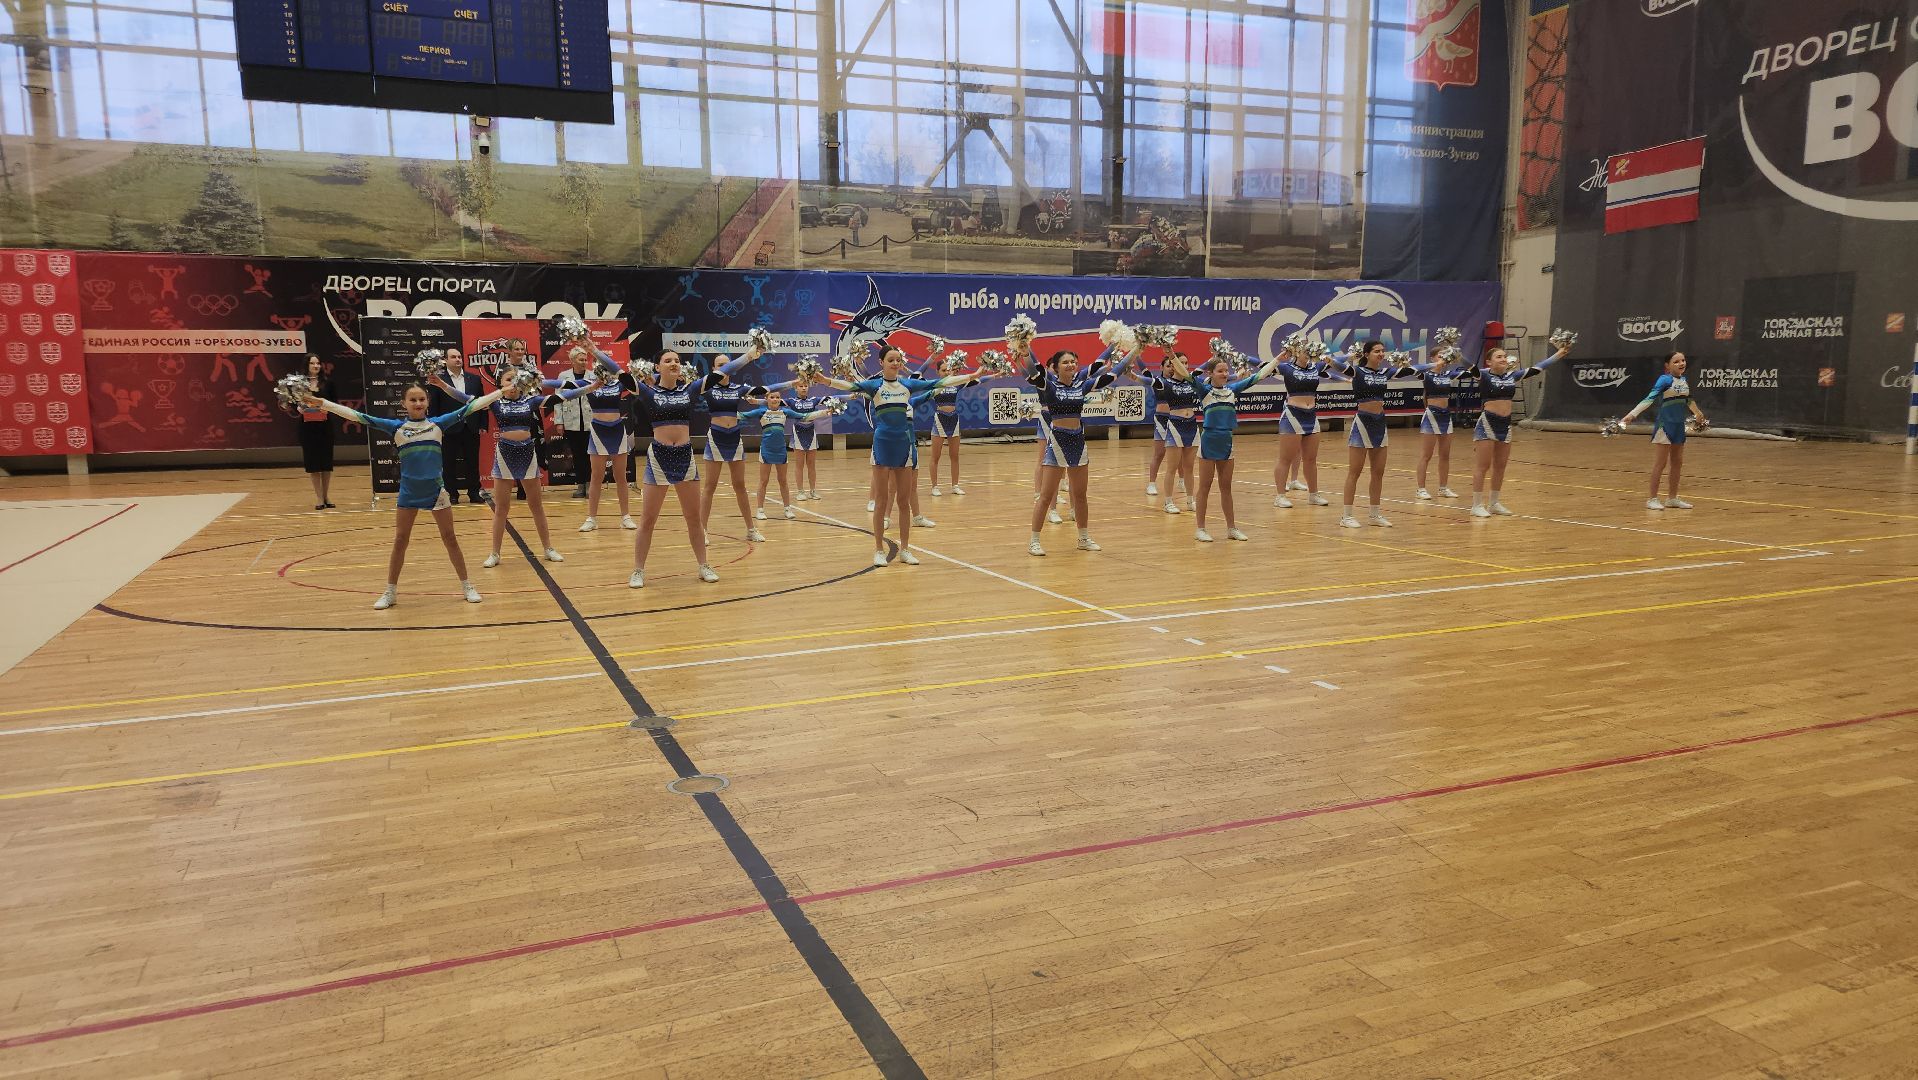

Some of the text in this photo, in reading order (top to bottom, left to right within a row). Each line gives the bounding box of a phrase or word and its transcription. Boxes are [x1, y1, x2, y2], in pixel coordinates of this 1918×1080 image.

[419, 45, 451, 56] ПЕРИОД
[1741, 17, 1899, 85] ДВОРЕЦ
[1391, 120, 1485, 139] Администрация
[1396, 143, 1480, 162] Орехово-Зуево
[322, 275, 496, 294] ДВОРЕЦ СПОРТА
[949, 287, 1261, 315] рыба морепродукты мясо птица
[1622, 320, 1682, 335] ВОСТОК
[1761, 328, 1844, 338] ЛЫЖНАЯ БАЗА
[142, 338, 191, 347] РОССИЯ
[195, 338, 303, 347] #ОРЕХОВО-ЗУЕВО
[1578, 367, 1627, 381] ВОСТОК
[1697, 379, 1779, 388] ЛЫЖНАЯ БАЗА
